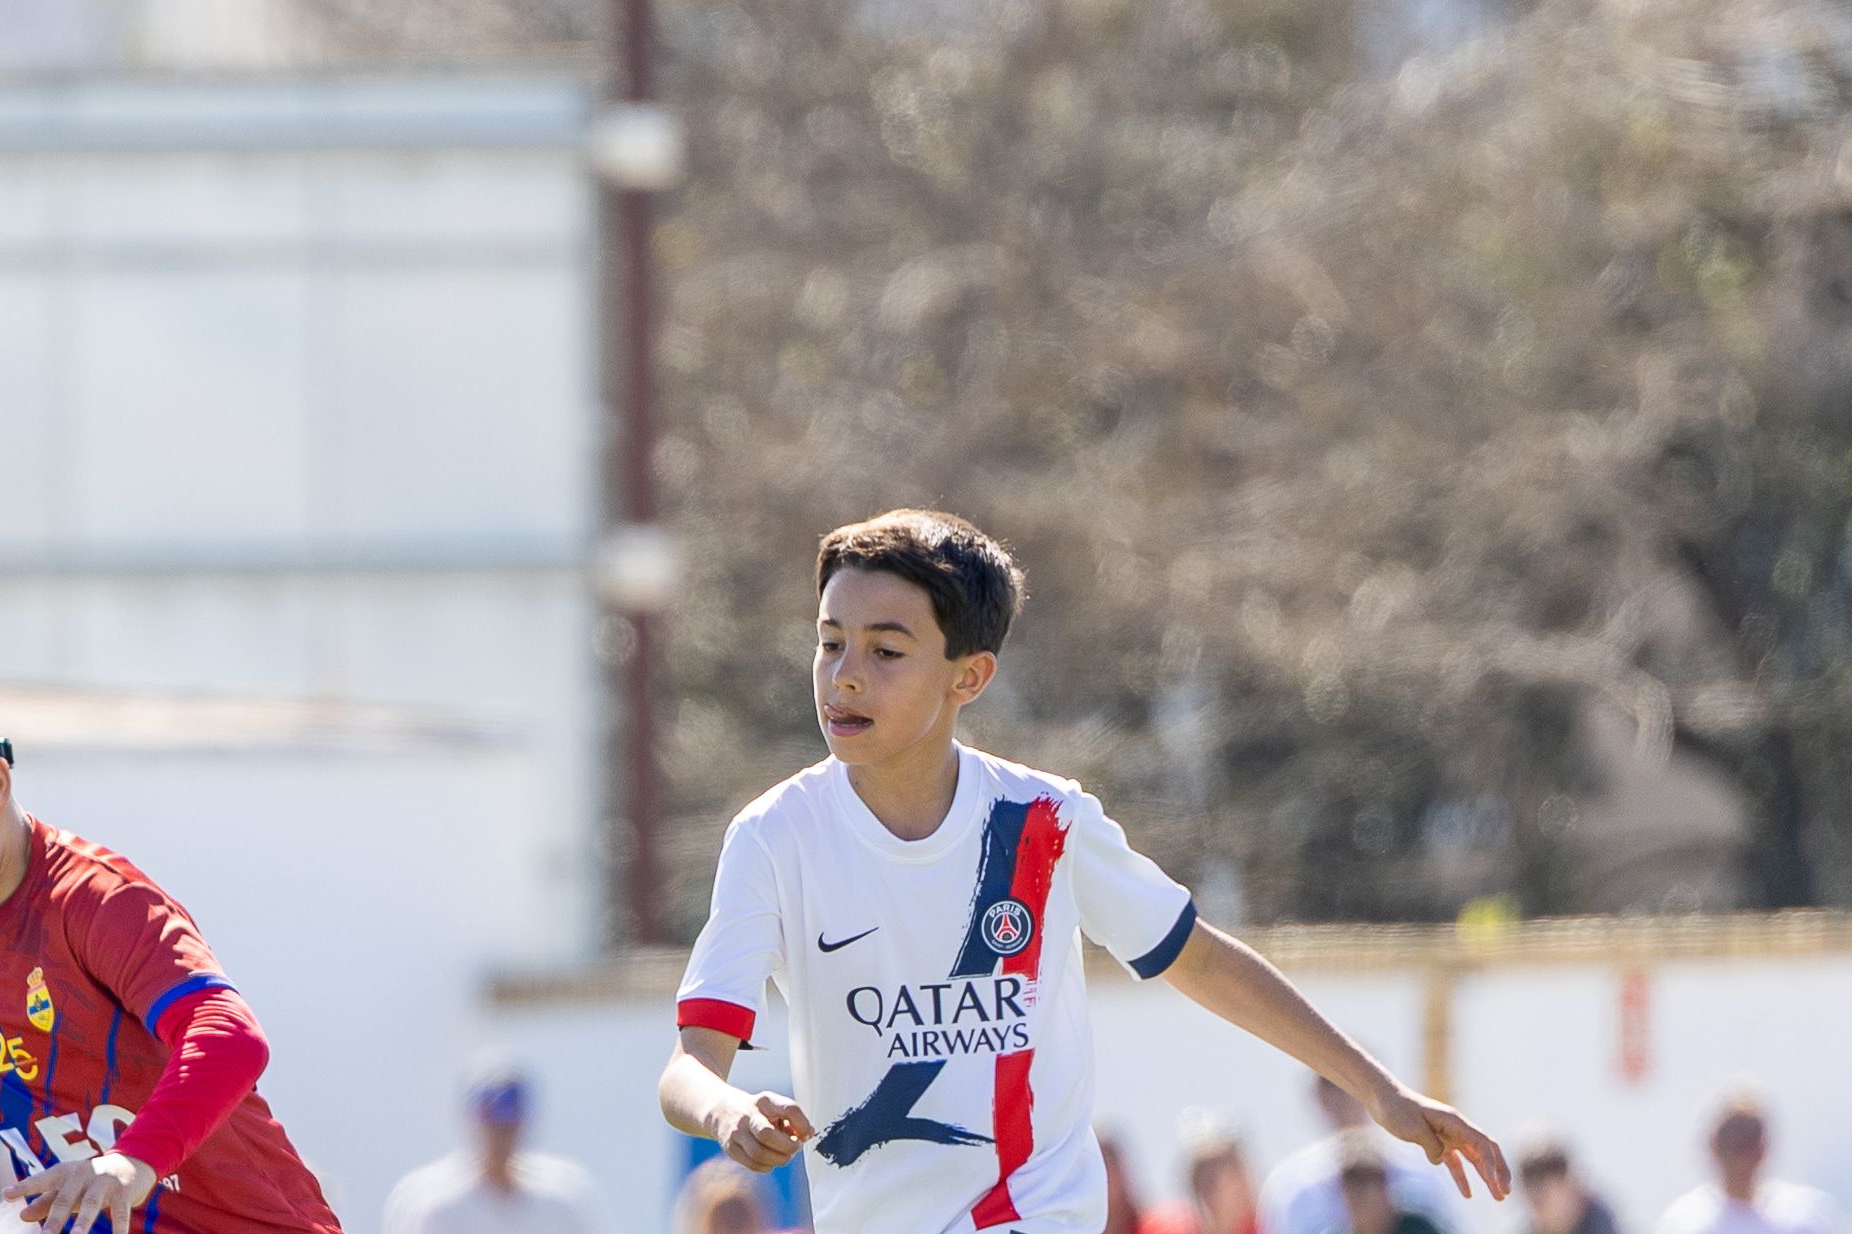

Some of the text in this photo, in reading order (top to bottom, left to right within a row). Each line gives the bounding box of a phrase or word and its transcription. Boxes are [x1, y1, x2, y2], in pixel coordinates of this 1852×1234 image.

[989, 903, 1022, 918] PARIS
[846, 977, 1027, 1038] QATAR
[887, 1022, 1030, 1059] AIRWAYS
